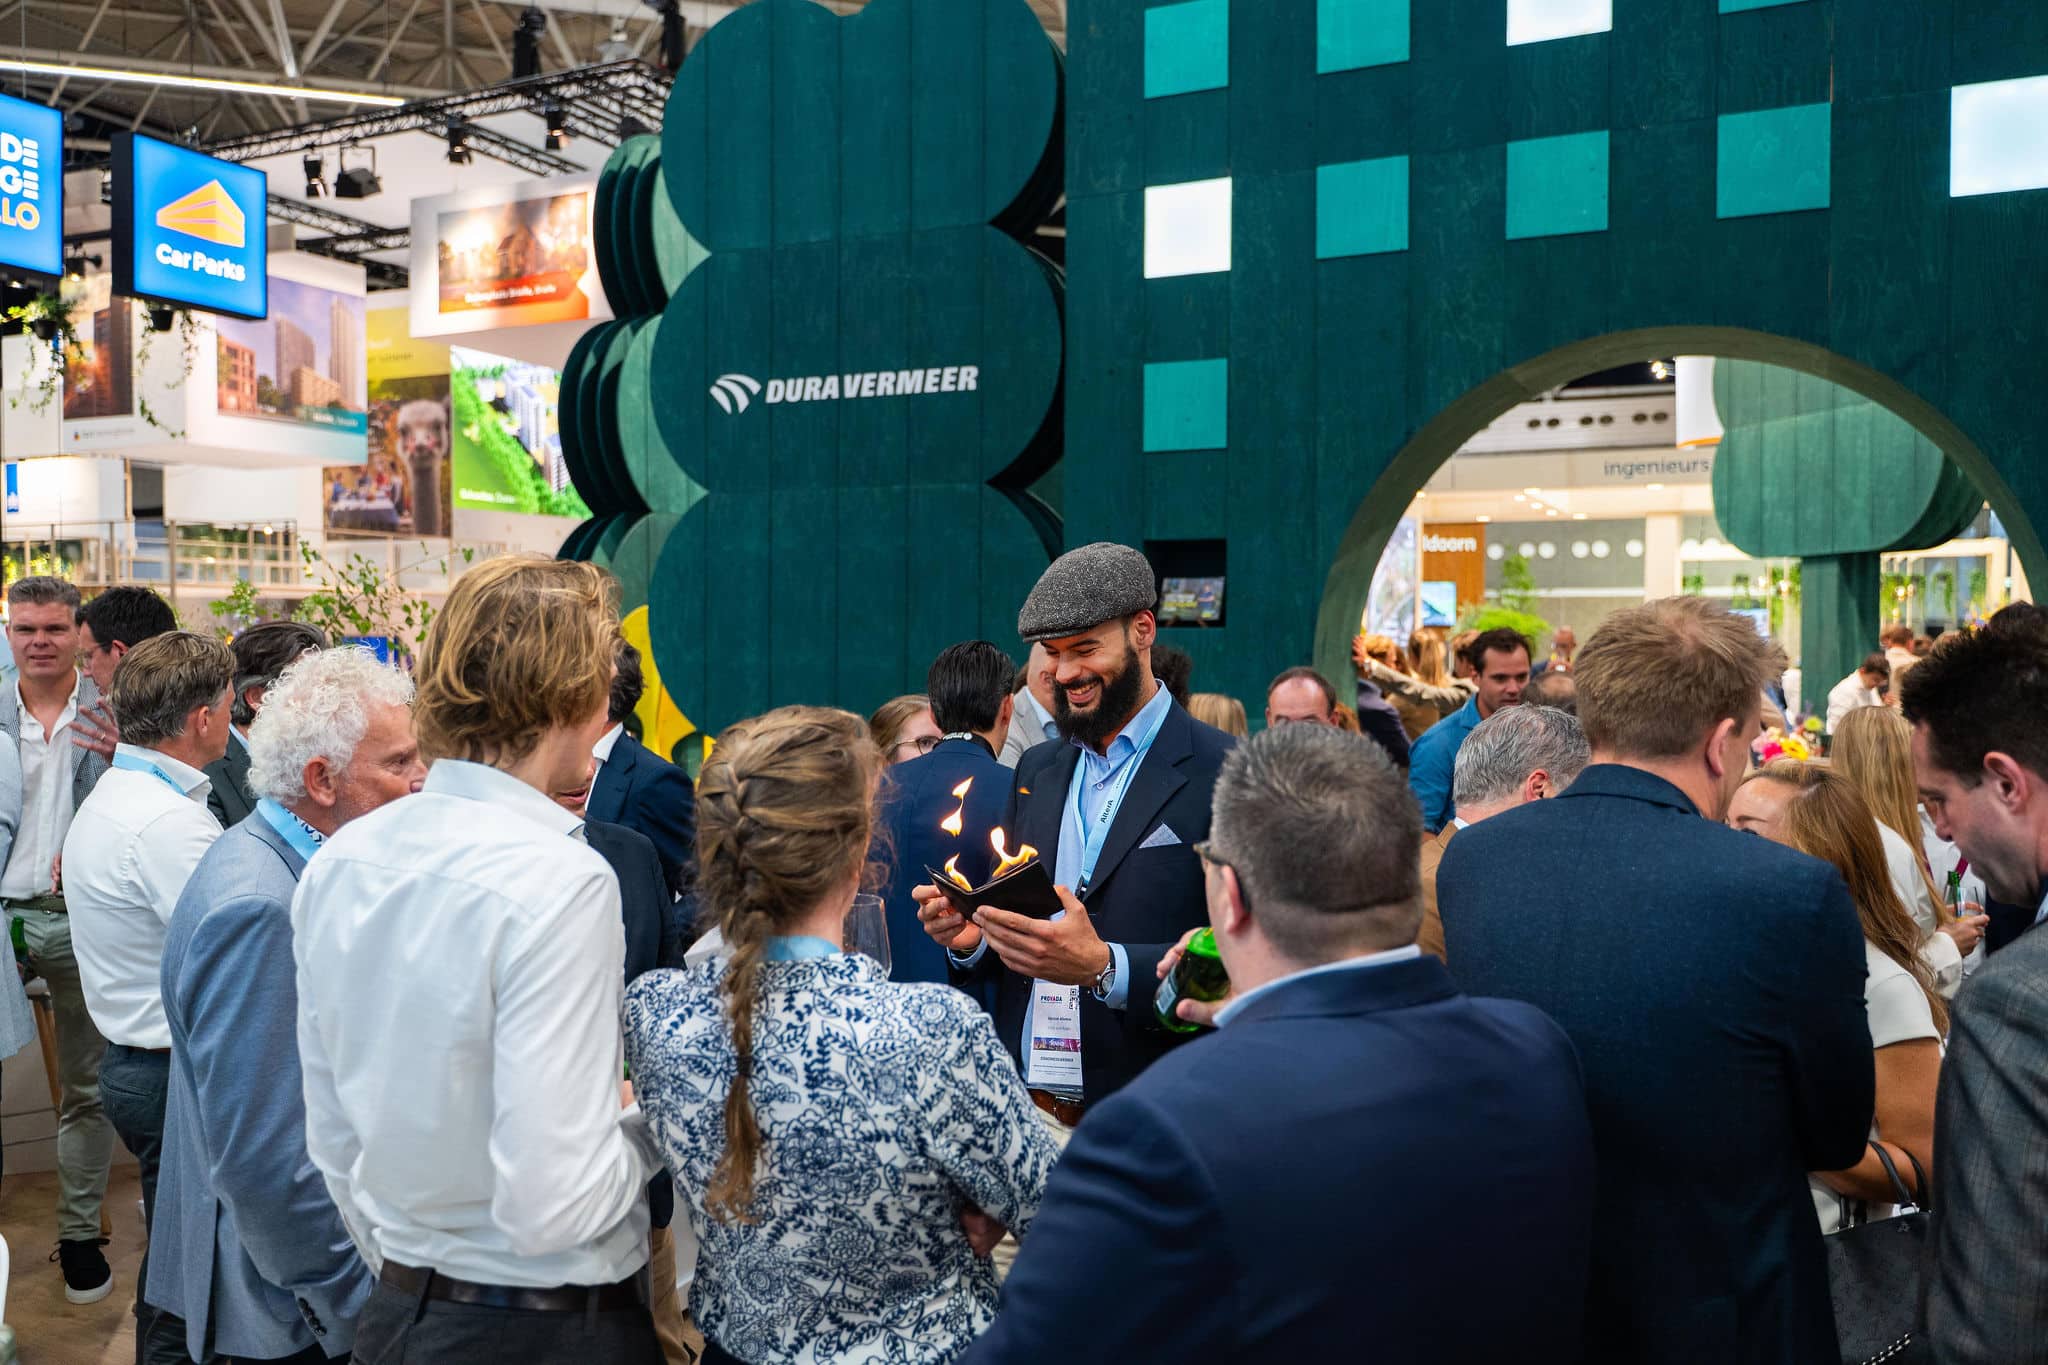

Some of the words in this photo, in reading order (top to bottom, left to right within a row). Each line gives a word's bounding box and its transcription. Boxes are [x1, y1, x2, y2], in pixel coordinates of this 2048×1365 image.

[156, 243, 192, 269] Car
[193, 251, 246, 282] Parks
[765, 375, 839, 404] DURA
[843, 365, 979, 398] VERMEER
[1603, 458, 1710, 480] ingenieurs
